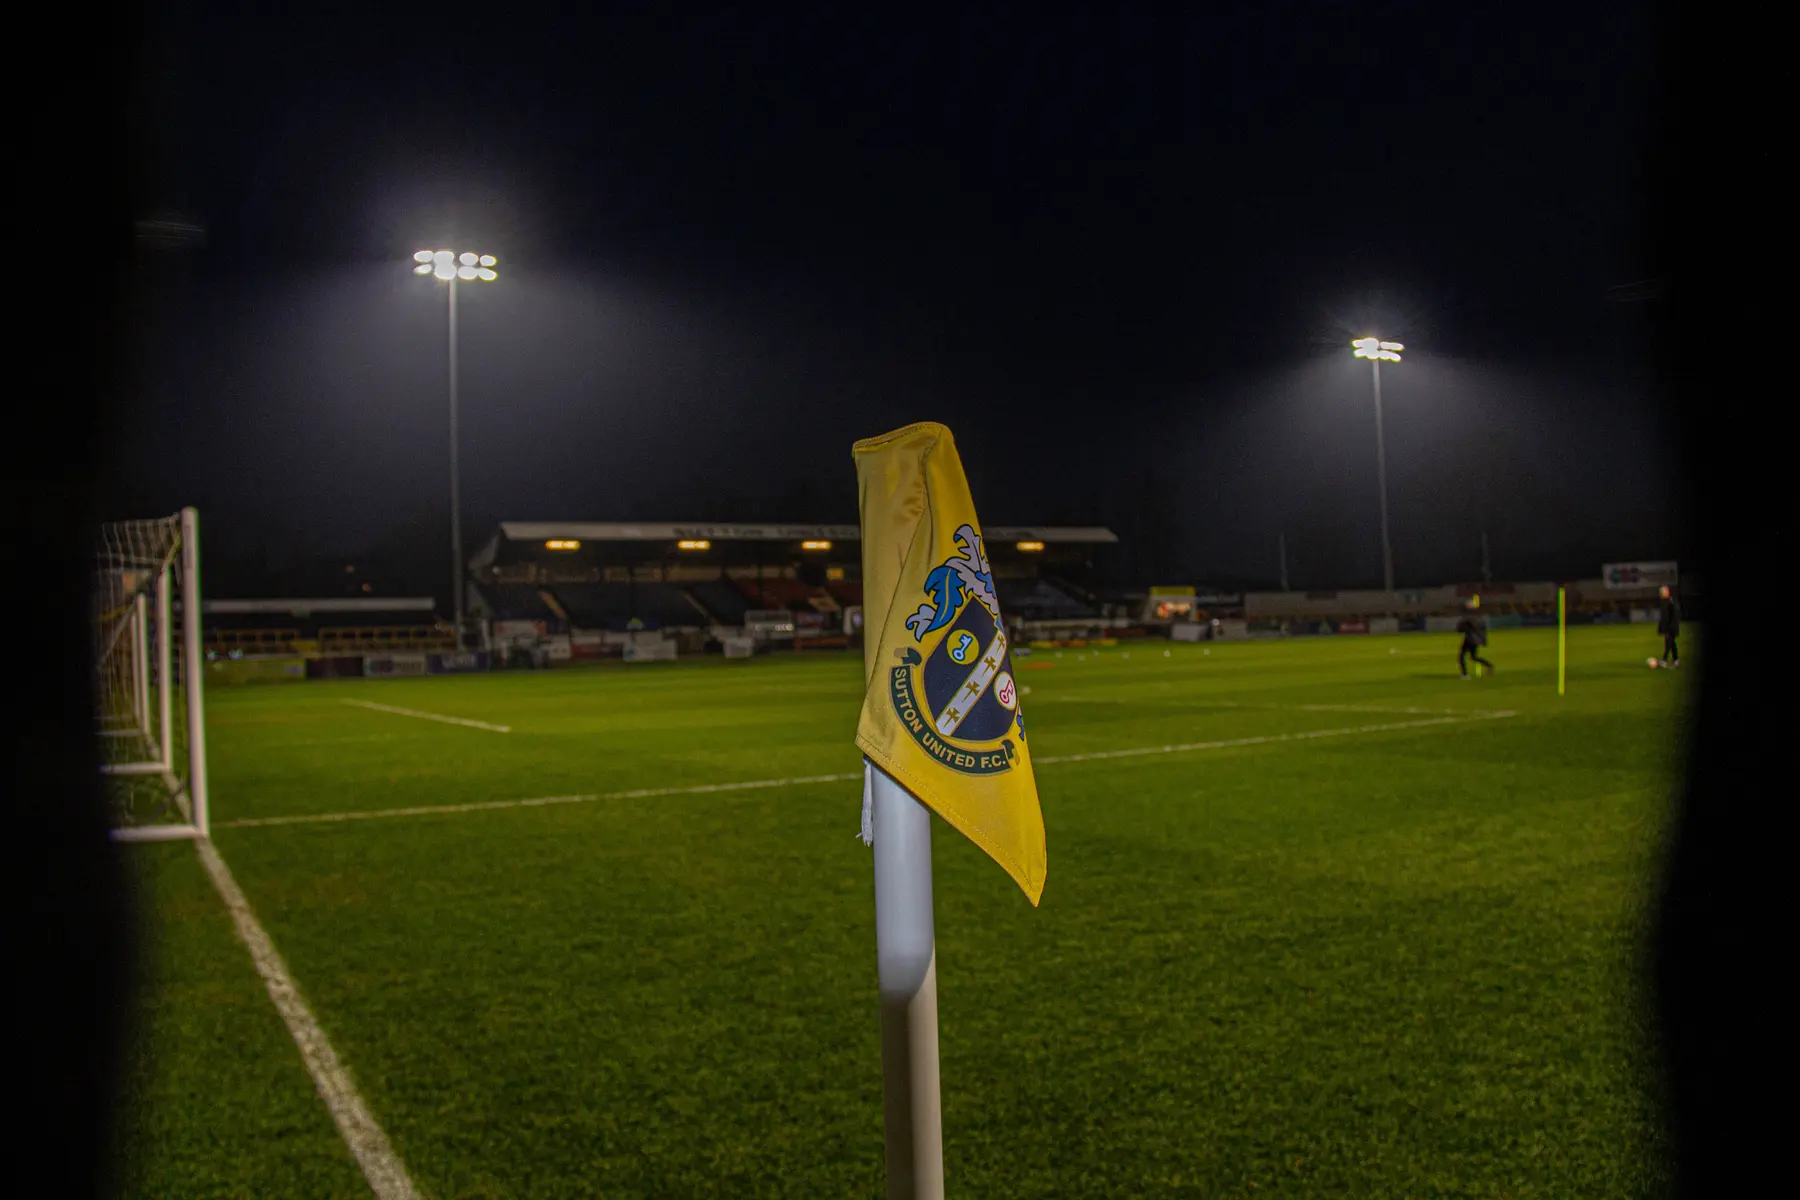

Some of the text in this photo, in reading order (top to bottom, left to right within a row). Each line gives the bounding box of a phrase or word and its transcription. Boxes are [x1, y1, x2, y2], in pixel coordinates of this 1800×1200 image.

[895, 668, 1006, 769] SUTTON UNITED F.C.
